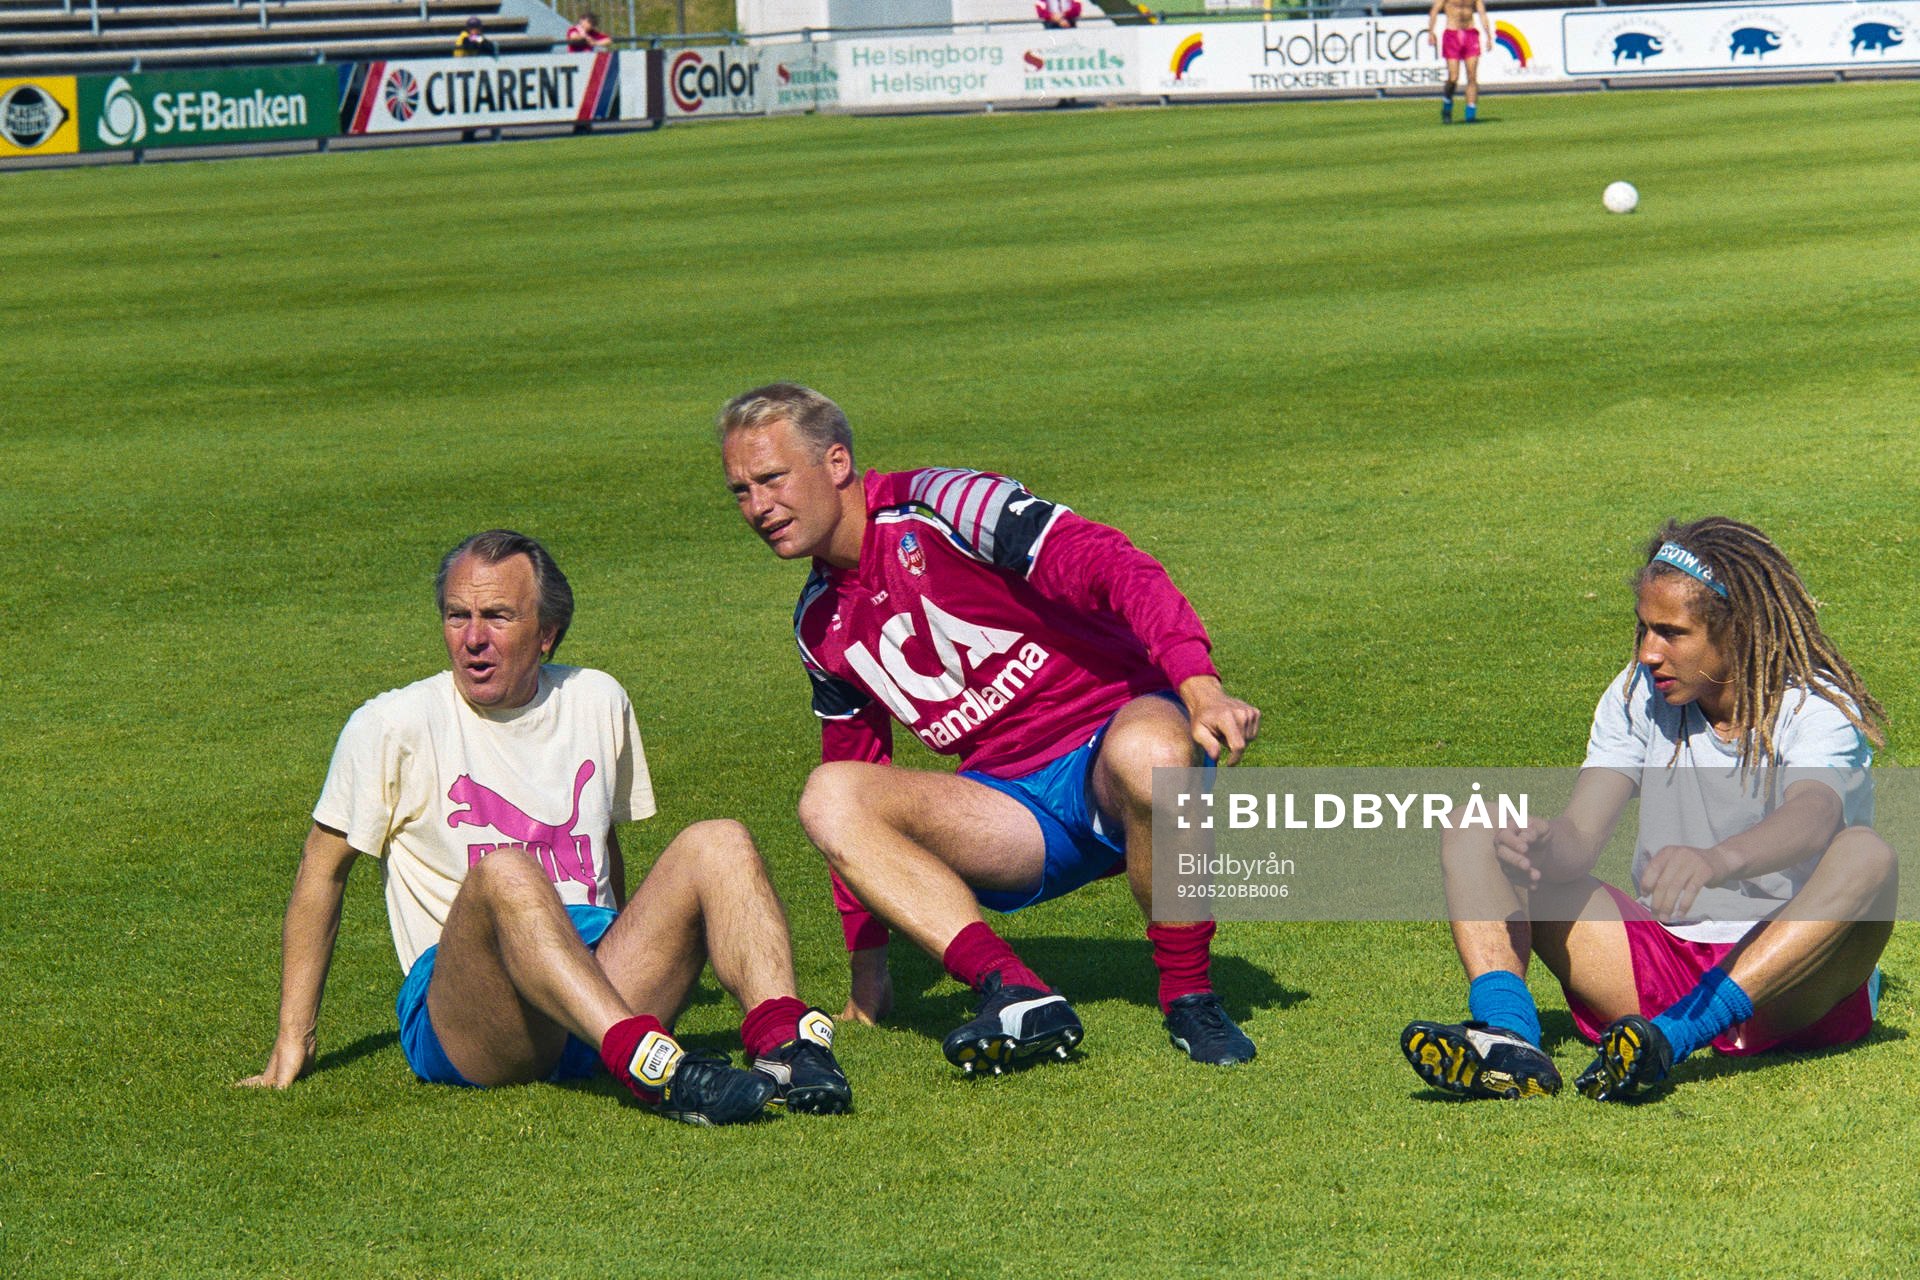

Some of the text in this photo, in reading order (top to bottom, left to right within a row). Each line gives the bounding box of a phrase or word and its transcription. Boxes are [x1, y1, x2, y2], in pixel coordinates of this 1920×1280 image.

[851, 42, 1004, 69] Helsingborg
[425, 65, 579, 116] CITARENT
[1249, 69, 1350, 89] TRYCKERIET
[1364, 67, 1448, 85] ELITSERIE
[844, 594, 1025, 724] ICA
